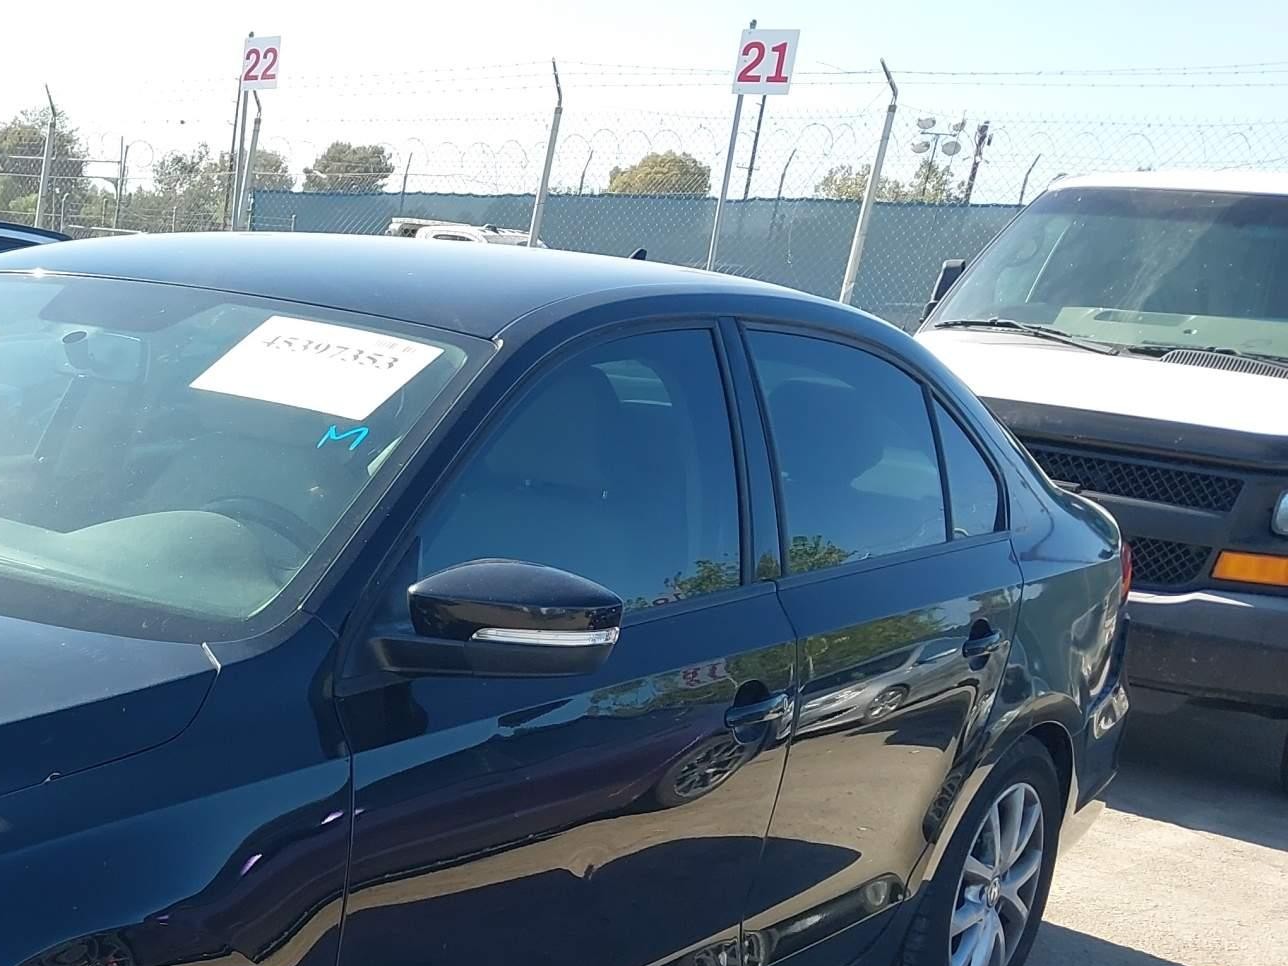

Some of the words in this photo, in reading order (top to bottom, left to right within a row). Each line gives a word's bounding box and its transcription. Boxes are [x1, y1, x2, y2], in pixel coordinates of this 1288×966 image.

[243, 47, 278, 81] 22
[737, 41, 788, 83] 21
[317, 425, 369, 450] M
